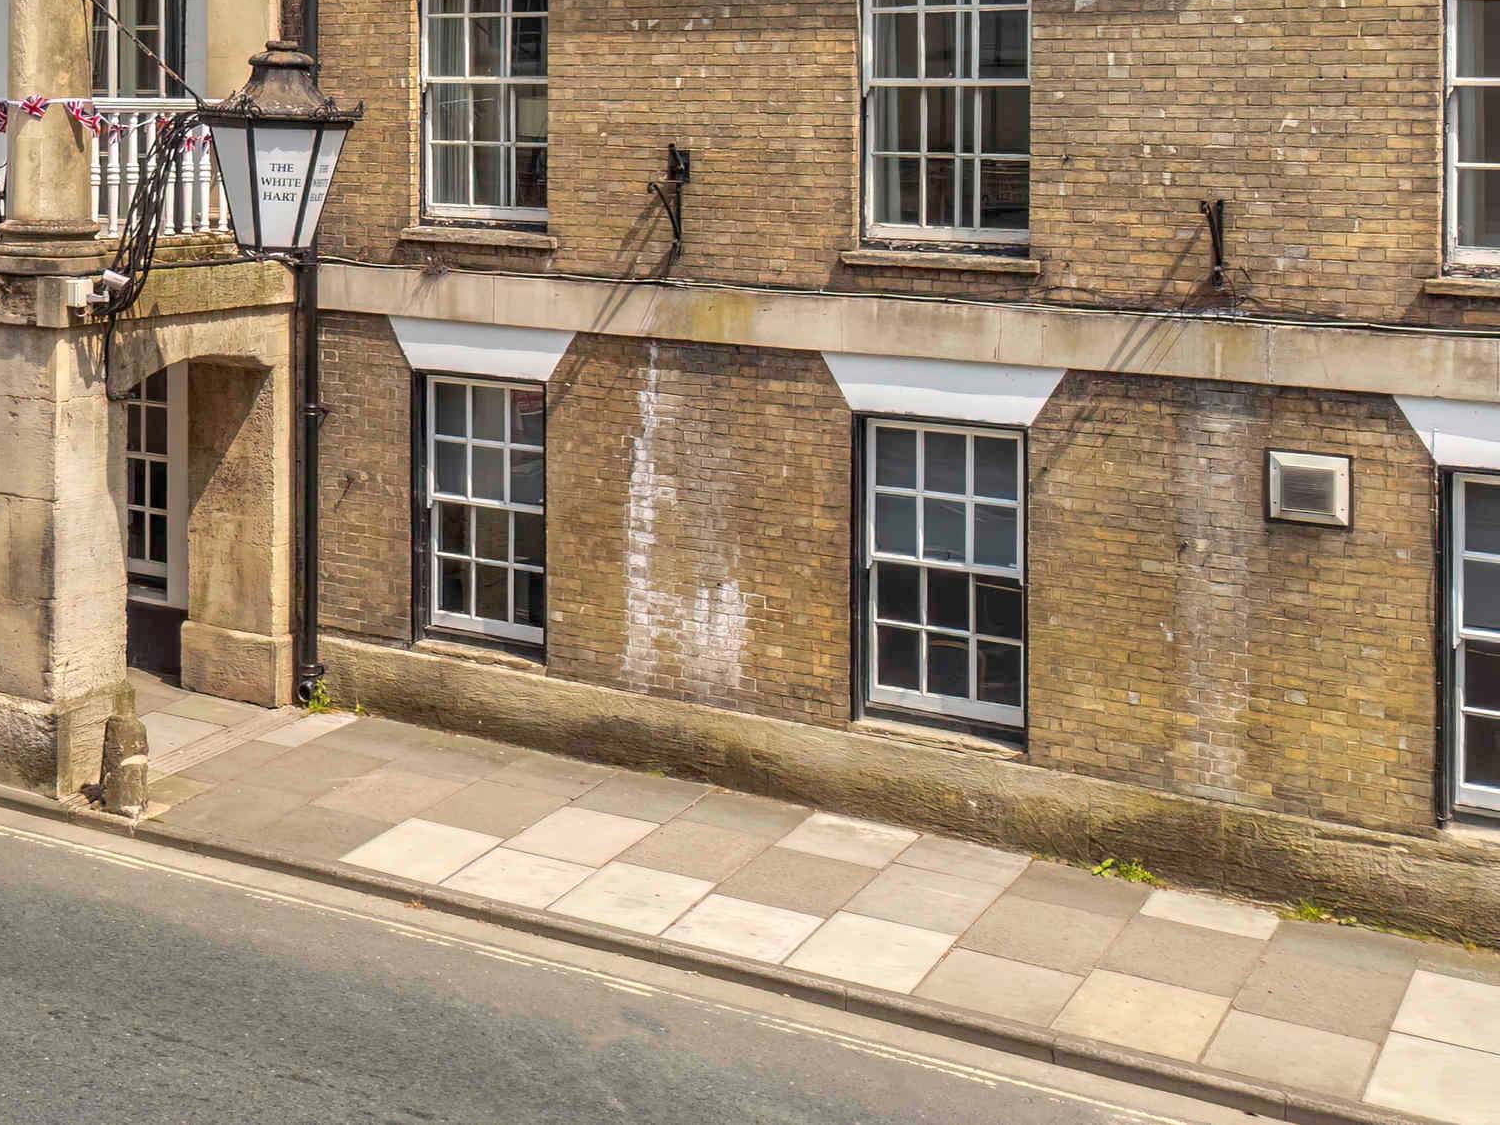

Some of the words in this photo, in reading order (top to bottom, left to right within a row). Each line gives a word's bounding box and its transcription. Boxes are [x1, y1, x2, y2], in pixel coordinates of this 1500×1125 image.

[269, 162, 295, 173] THE
[260, 176, 302, 188] WHITE
[262, 191, 298, 202] HART
